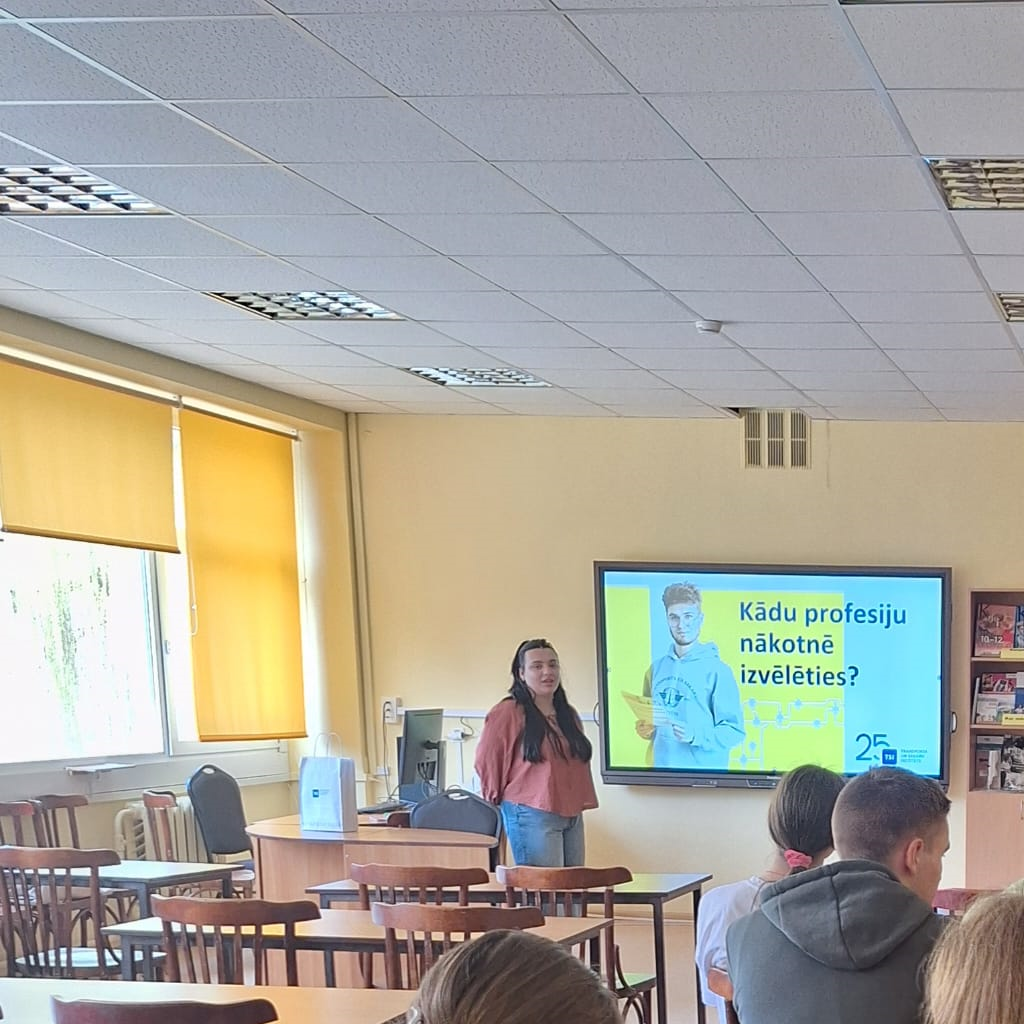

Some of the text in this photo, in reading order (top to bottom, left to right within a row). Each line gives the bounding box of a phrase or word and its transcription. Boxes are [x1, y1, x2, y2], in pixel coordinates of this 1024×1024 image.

[740, 601, 906, 629] Kādu profesiju
[740, 632, 834, 654] nākotnē
[741, 664, 859, 687] izvēlēties?
[855, 733, 890, 761] 25
